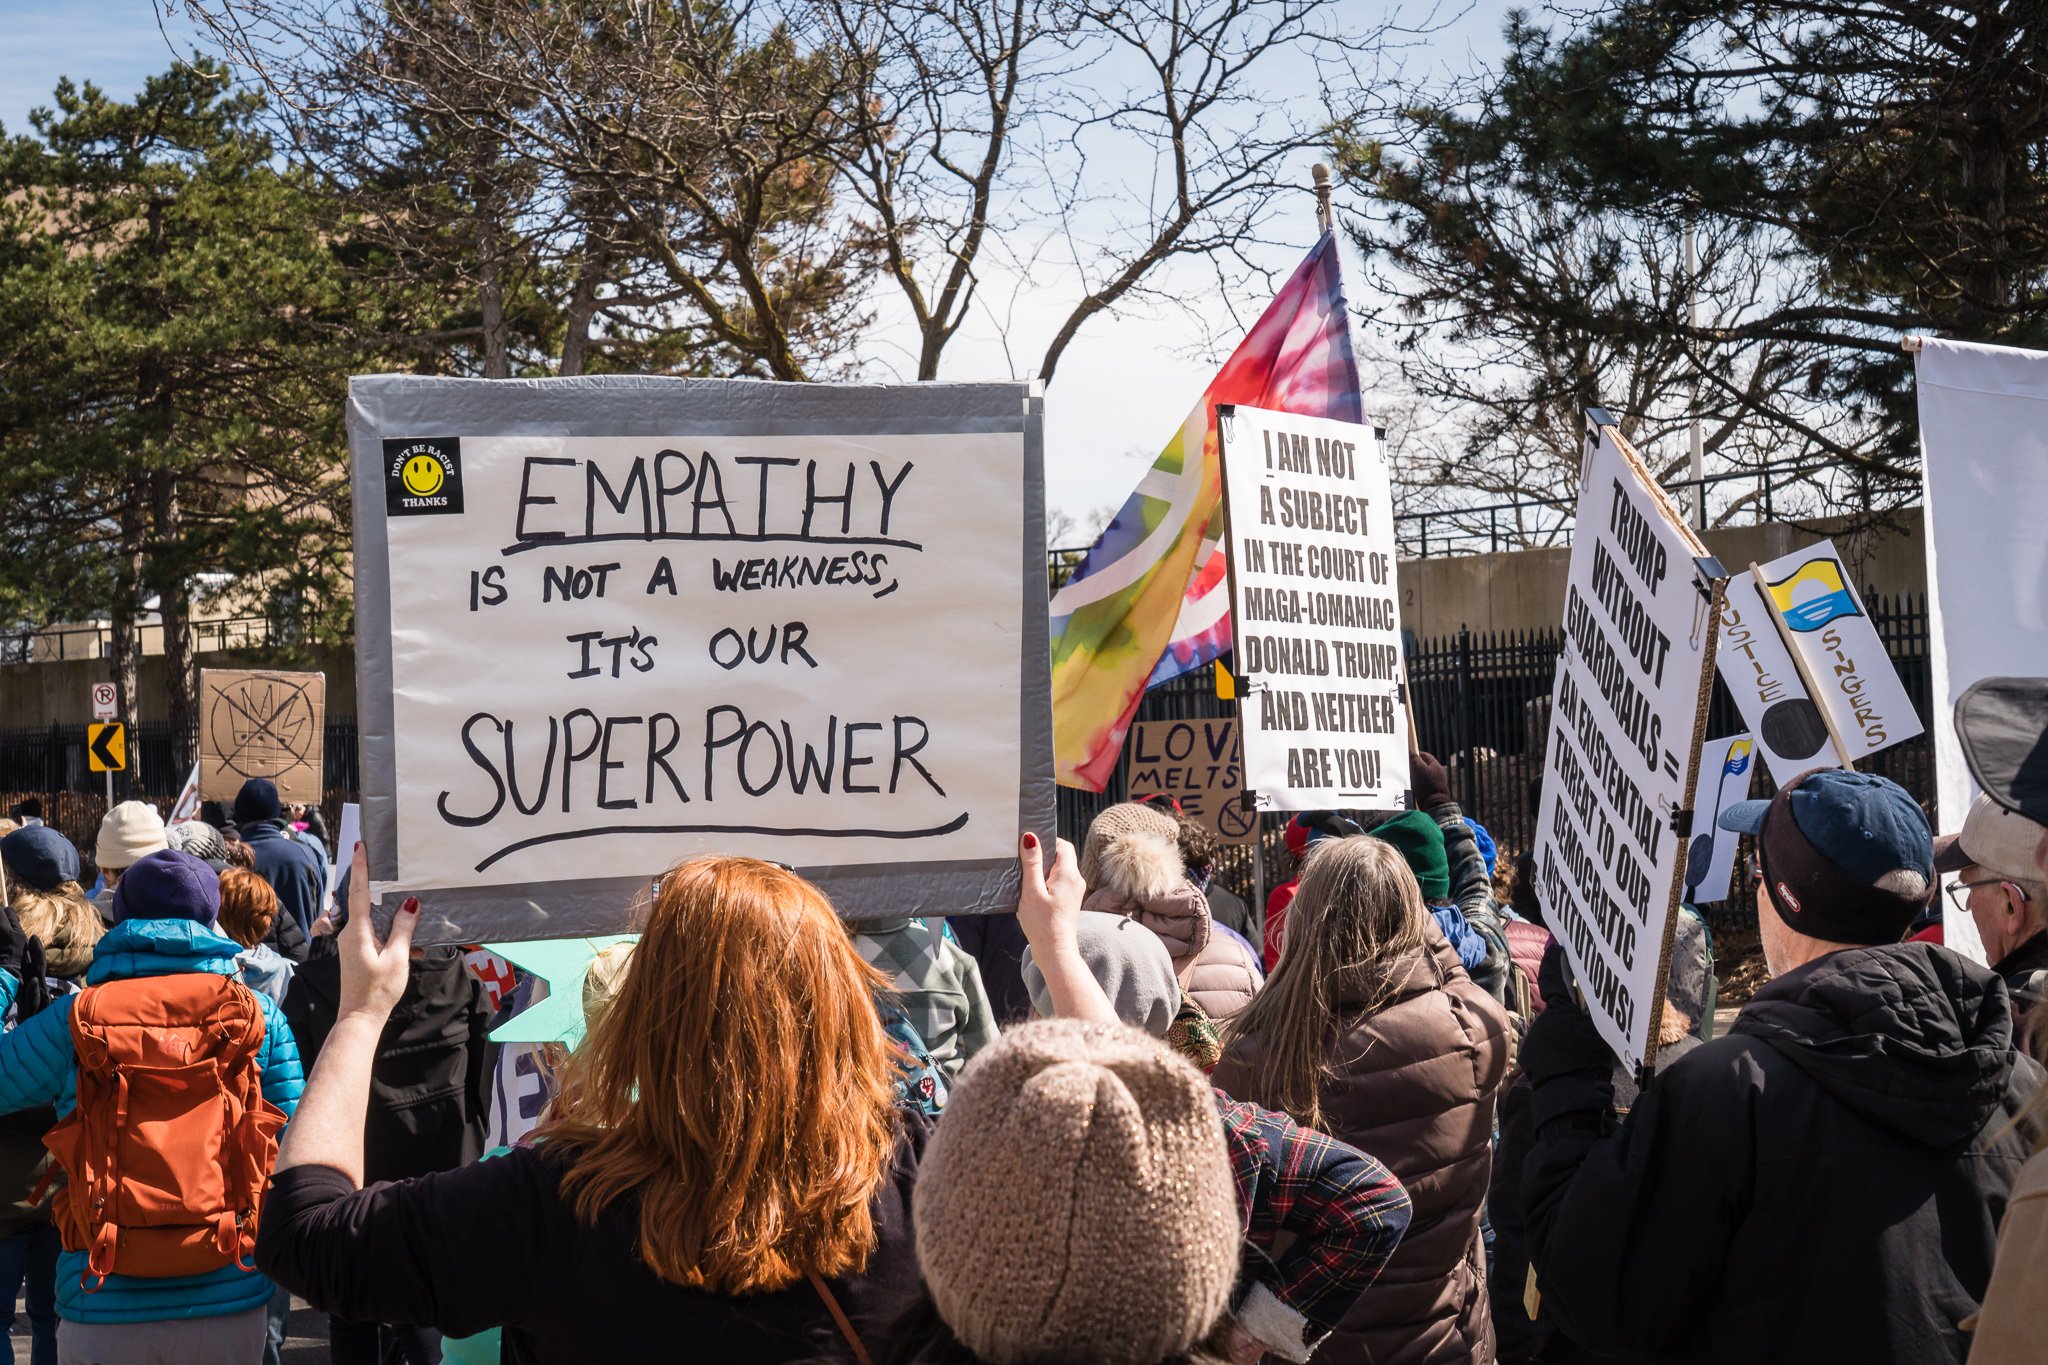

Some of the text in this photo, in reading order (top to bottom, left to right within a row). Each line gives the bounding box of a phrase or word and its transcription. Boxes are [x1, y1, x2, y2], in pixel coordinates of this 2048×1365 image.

[392, 445, 455, 477] DON'T BE RACIST
[1264, 431, 1355, 480] I AM NOT
[403, 497, 448, 507] THANKS
[516, 450, 913, 540] EMPATHY
[1261, 485, 1368, 536] A SUBJECT
[1245, 539, 1388, 584] IN THE COURT OF
[1611, 477, 1666, 597] TRUMP
[470, 551, 898, 611] IS NOT A WEAKNESS,
[1245, 587, 1394, 631] MAGA-LOMANIAC
[1592, 537, 1670, 689] WITHOUT
[566, 622, 818, 679] IT'S OUR
[1246, 636, 1398, 683] DONALD TRUMP,
[1567, 584, 1662, 770] GUARDRAILS
[1262, 691, 1394, 733] AND NEITHER
[1822, 629, 1887, 748] SINGERS
[1131, 765, 1240, 790] MELTS
[1288, 749, 1381, 788] ARE YOU!
[1558, 668, 1662, 868] AN EXISTENTIAL
[1555, 726, 1650, 927] THREAT TO OUR
[1553, 794, 1636, 971] DEMOCRATIC
[1543, 841, 1634, 1043] INSTITUTIONS!
